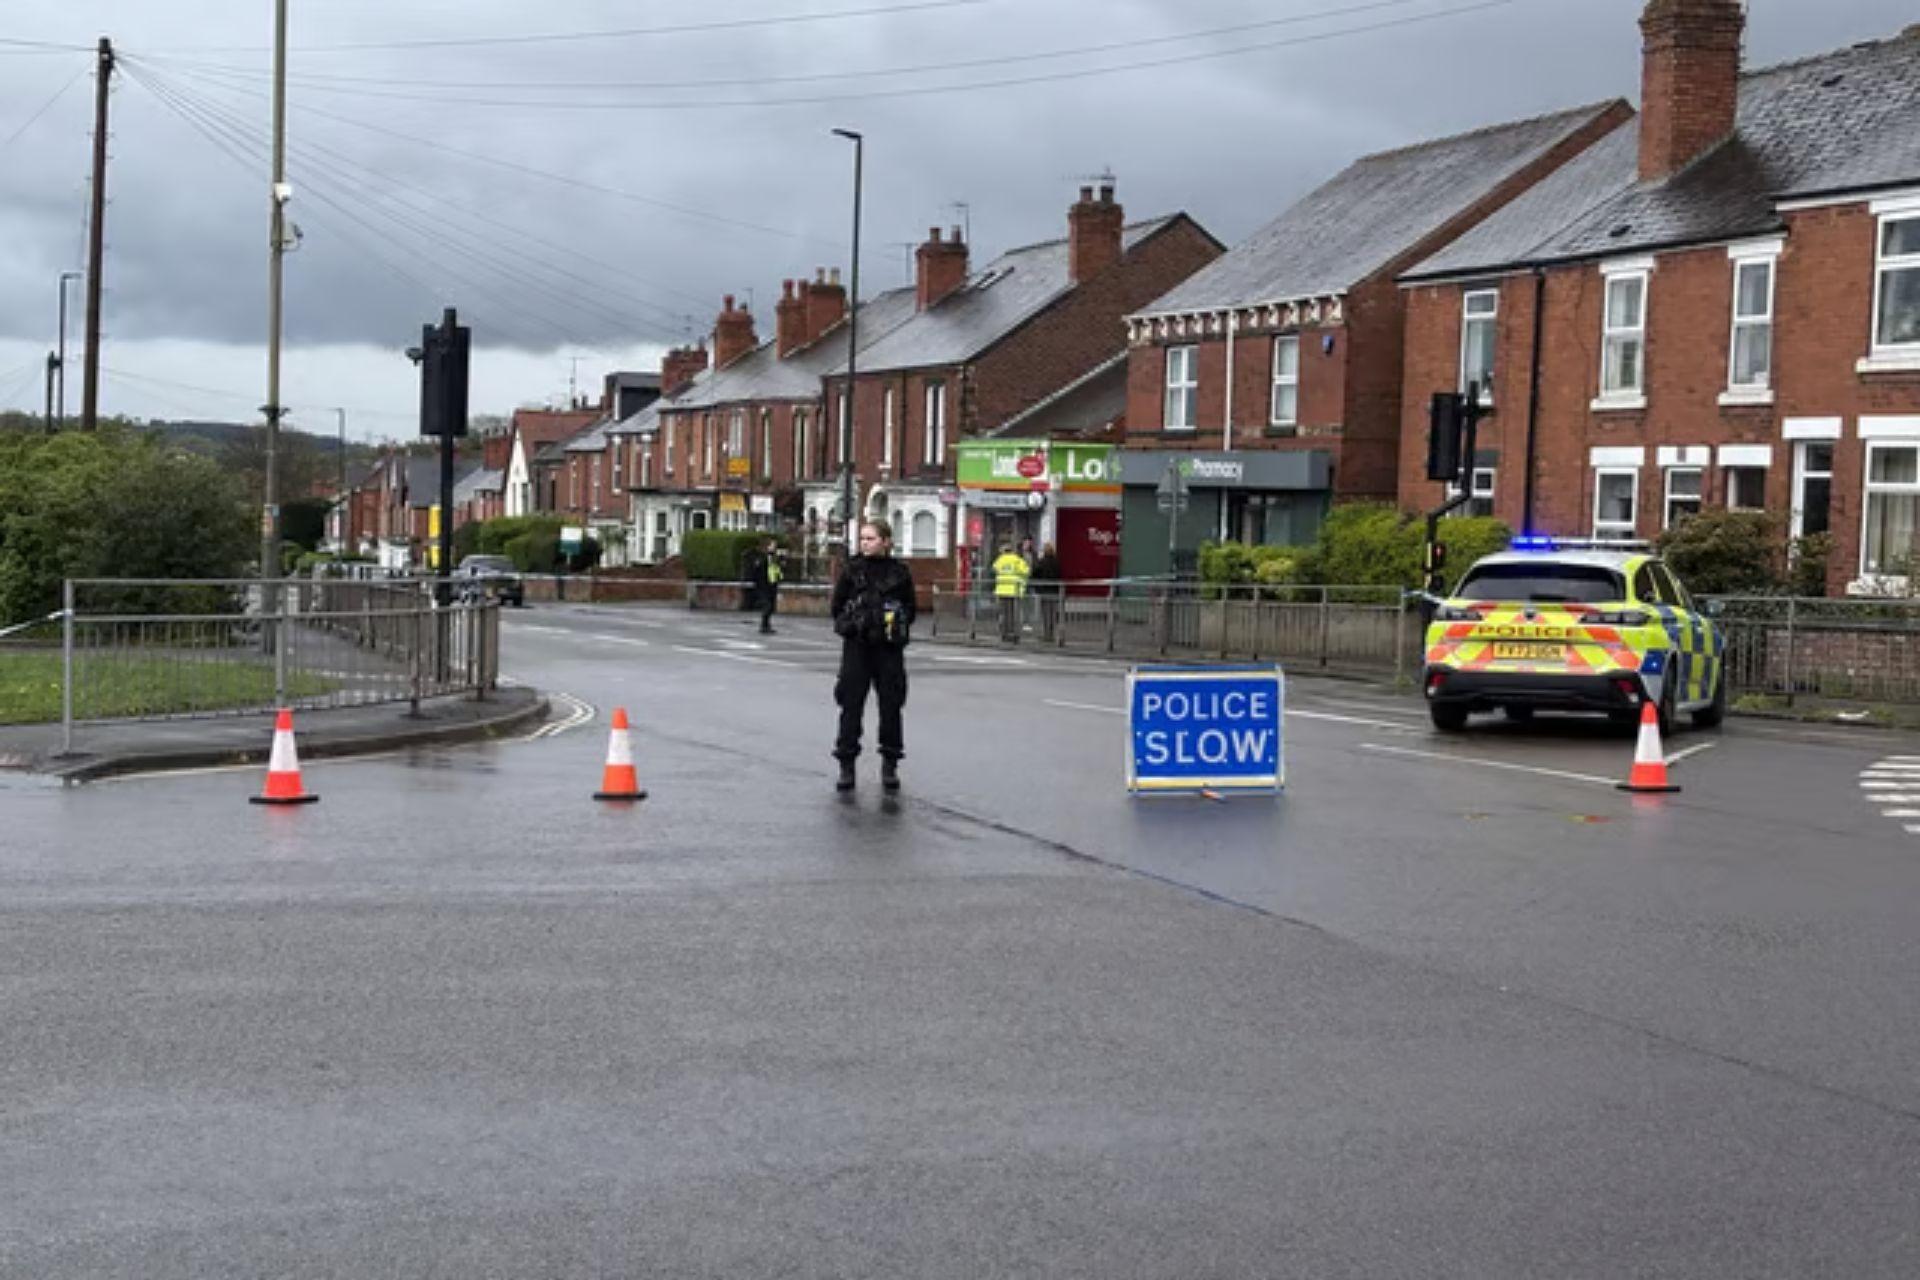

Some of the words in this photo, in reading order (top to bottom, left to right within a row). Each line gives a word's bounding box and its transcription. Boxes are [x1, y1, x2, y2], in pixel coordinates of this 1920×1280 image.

[1477, 625, 1582, 638] POLICE
[1142, 692, 1267, 720] POLICE
[1144, 729, 1267, 764] SLOW
